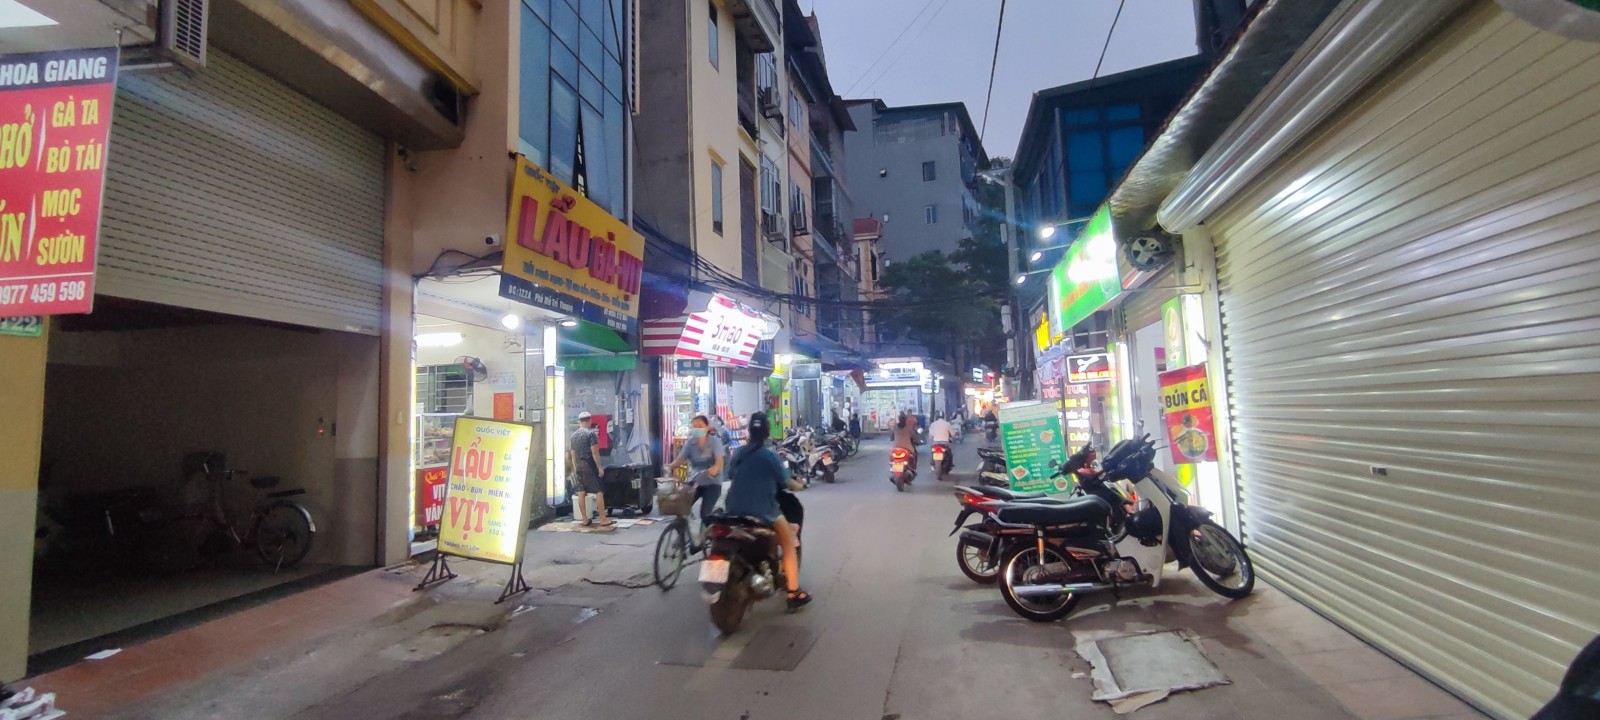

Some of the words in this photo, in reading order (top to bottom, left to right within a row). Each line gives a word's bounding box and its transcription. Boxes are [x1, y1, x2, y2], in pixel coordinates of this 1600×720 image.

[0, 63, 39, 86] HOA
[45, 57, 107, 83] GIANG
[52, 95, 75, 128] GÀ
[81, 98, 99, 126] TA
[0, 103, 35, 169] HỞ
[46, 139, 71, 173] BÒ
[75, 138, 102, 171] TÁI
[41, 187, 82, 223] MỌC
[37, 229, 85, 266] SƯỜN
[517, 195, 591, 269] LẨU
[0, 284, 28, 306] 977
[30, 282, 57, 304] 459
[58, 281, 86, 302] 598
[1165, 389, 1188, 408] BÚN
[1191, 383, 1207, 403] CÁ
[475, 425, 496, 435] QUỐC
[452, 436, 495, 481] LẨU
[449, 495, 490, 541] VỊT
